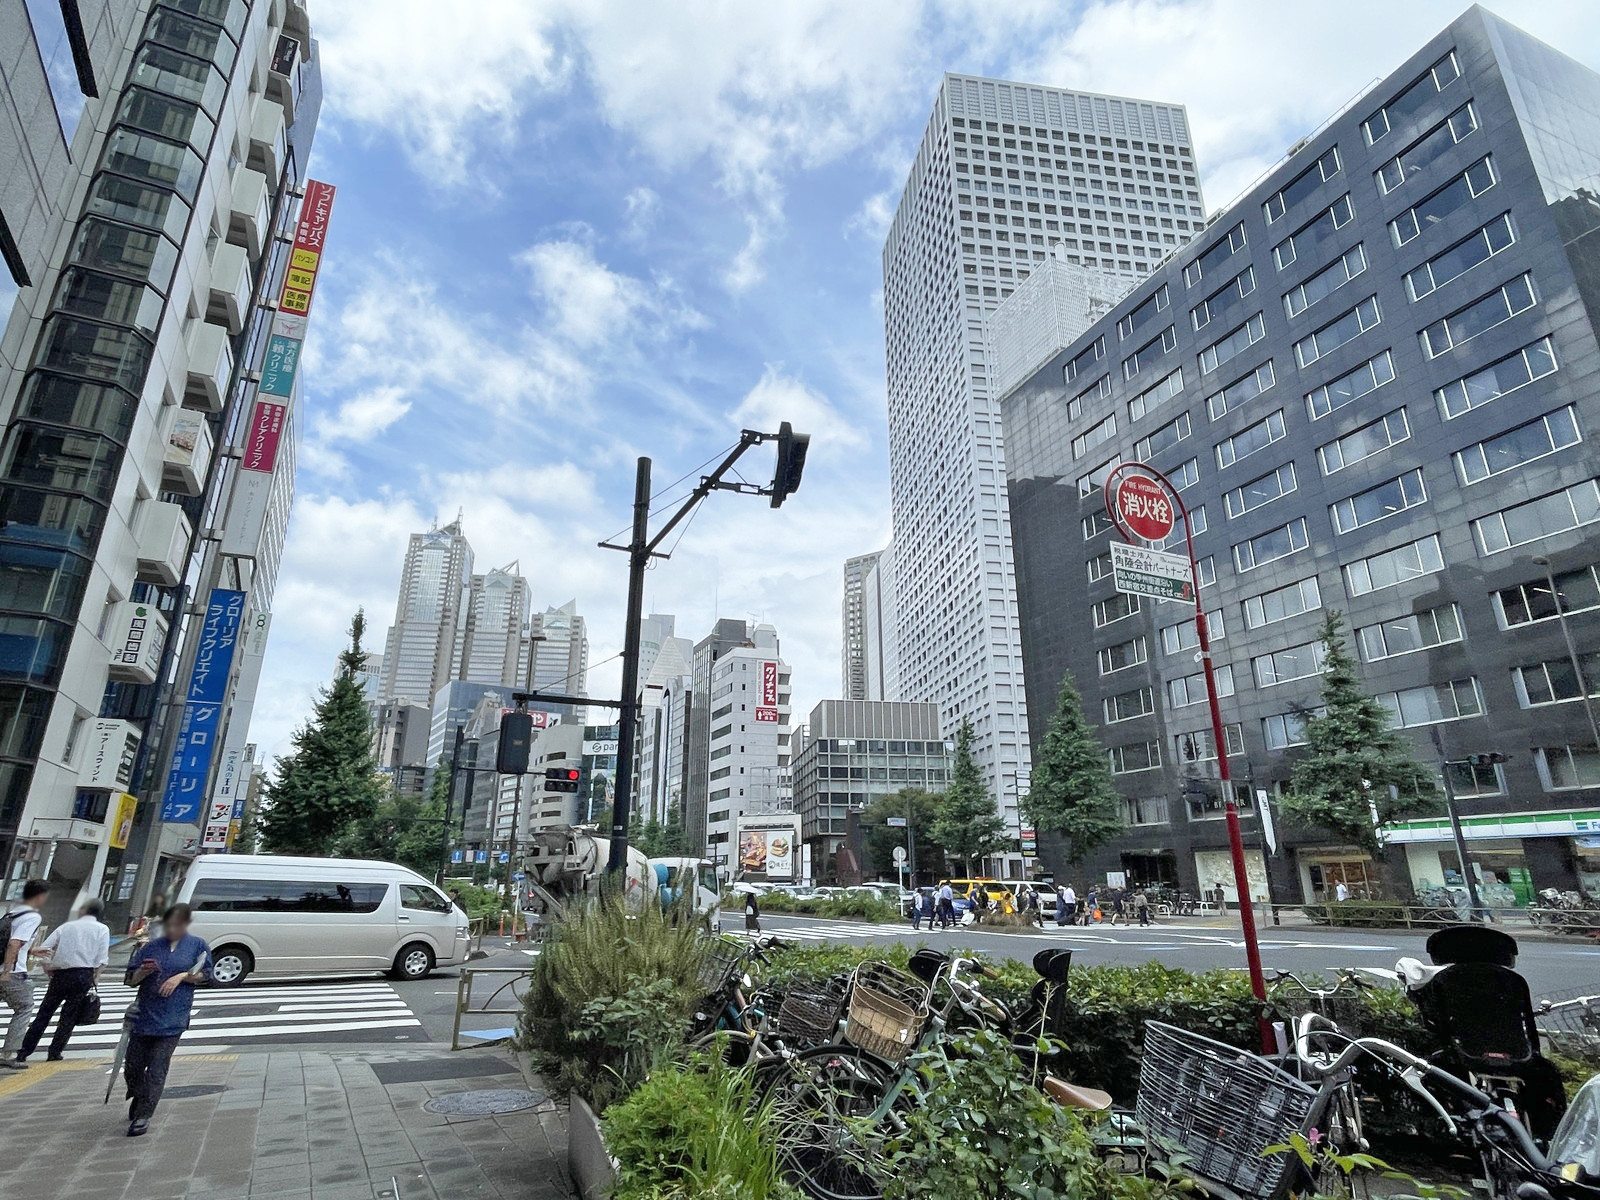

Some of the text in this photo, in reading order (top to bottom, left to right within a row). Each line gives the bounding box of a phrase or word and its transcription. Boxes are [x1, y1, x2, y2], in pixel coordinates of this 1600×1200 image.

[308, 185, 333, 247] ソフトキャンパス
[294, 254, 316, 264] パソコン
[291, 274, 311, 285] 簿記
[286, 291, 307, 301] 医療
[285, 299, 306, 310] 事務
[1125, 481, 1161, 494] FIRE HYDRANT
[1122, 491, 1170, 524] 消火栓
[1114, 547, 1153, 561] 税理士法人
[219, 594, 244, 649] グローリア
[190, 604, 224, 697] ライフクリエイト
[175, 706, 217, 818] グローリア
